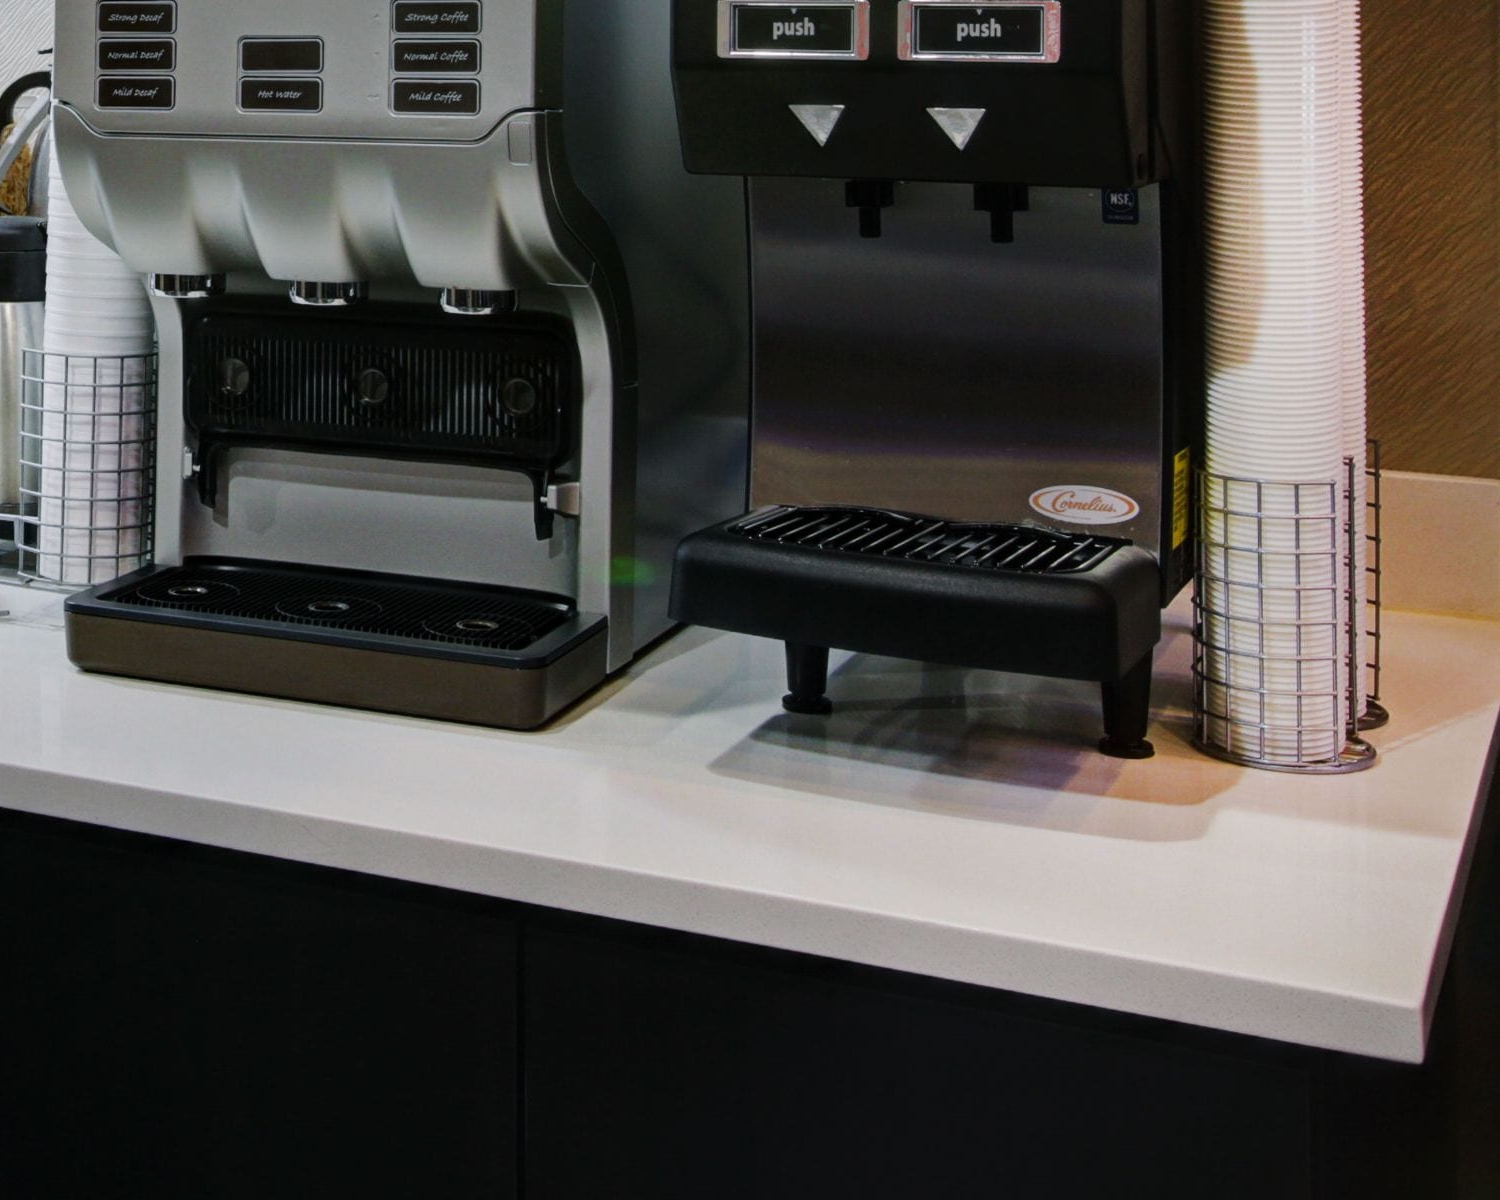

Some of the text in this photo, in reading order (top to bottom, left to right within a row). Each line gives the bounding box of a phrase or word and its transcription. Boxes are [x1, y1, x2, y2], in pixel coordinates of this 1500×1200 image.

[108, 12, 165, 24] Strong Decaf
[404, 11, 469, 24] Strong Coffee
[772, 16, 816, 40] push
[956, 17, 1002, 42] push
[107, 49, 165, 61] Normal Decaf
[403, 50, 469, 64] Normal Coffee
[112, 86, 160, 100] Mild Decaf
[257, 90, 274, 99] Hot
[408, 91, 463, 104] Mild Coffee
[1051, 490, 1113, 513] Cornelius
